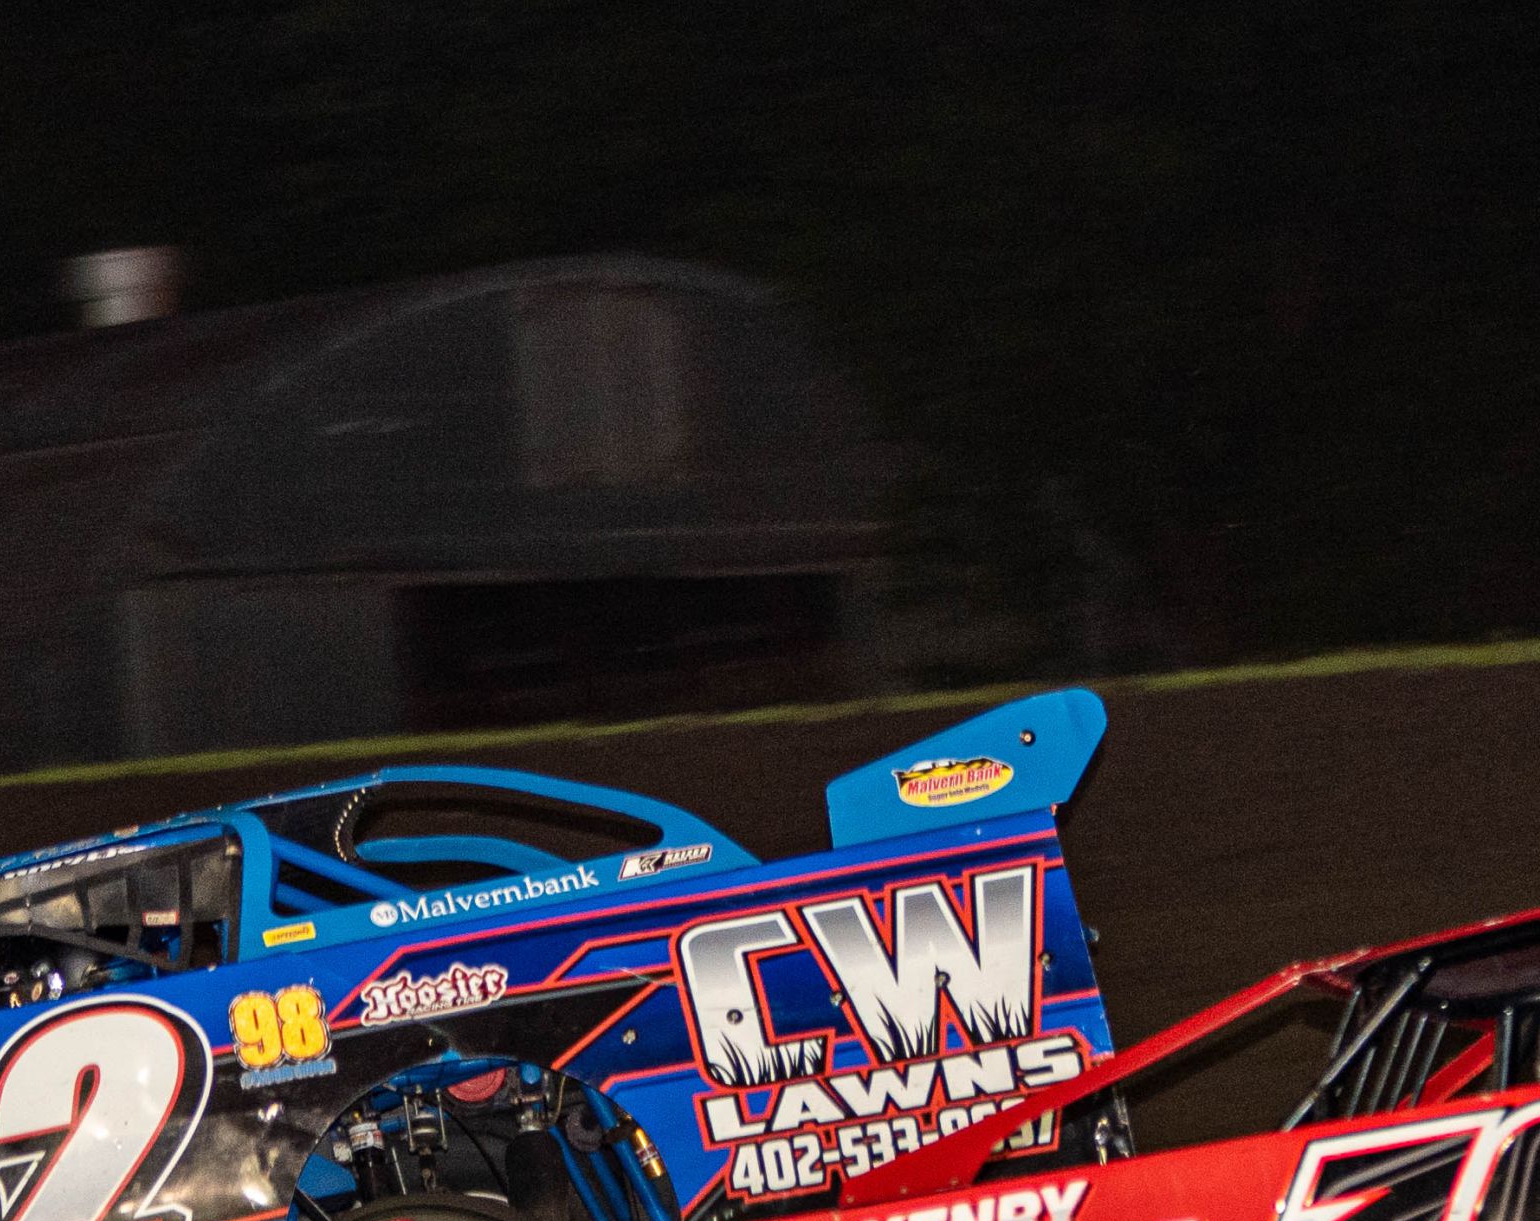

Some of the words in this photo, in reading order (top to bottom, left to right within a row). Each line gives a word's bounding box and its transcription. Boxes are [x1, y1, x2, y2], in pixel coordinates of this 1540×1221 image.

[907, 772, 963, 796] Malvern
[967, 762, 1003, 783] Bank
[398, 865, 600, 923] Malvern.bank
[363, 966, 505, 1021] Hoosier
[680, 868, 1038, 1090] CW
[231, 986, 329, 1068] 98
[705, 1036, 1084, 1143] LAWNS
